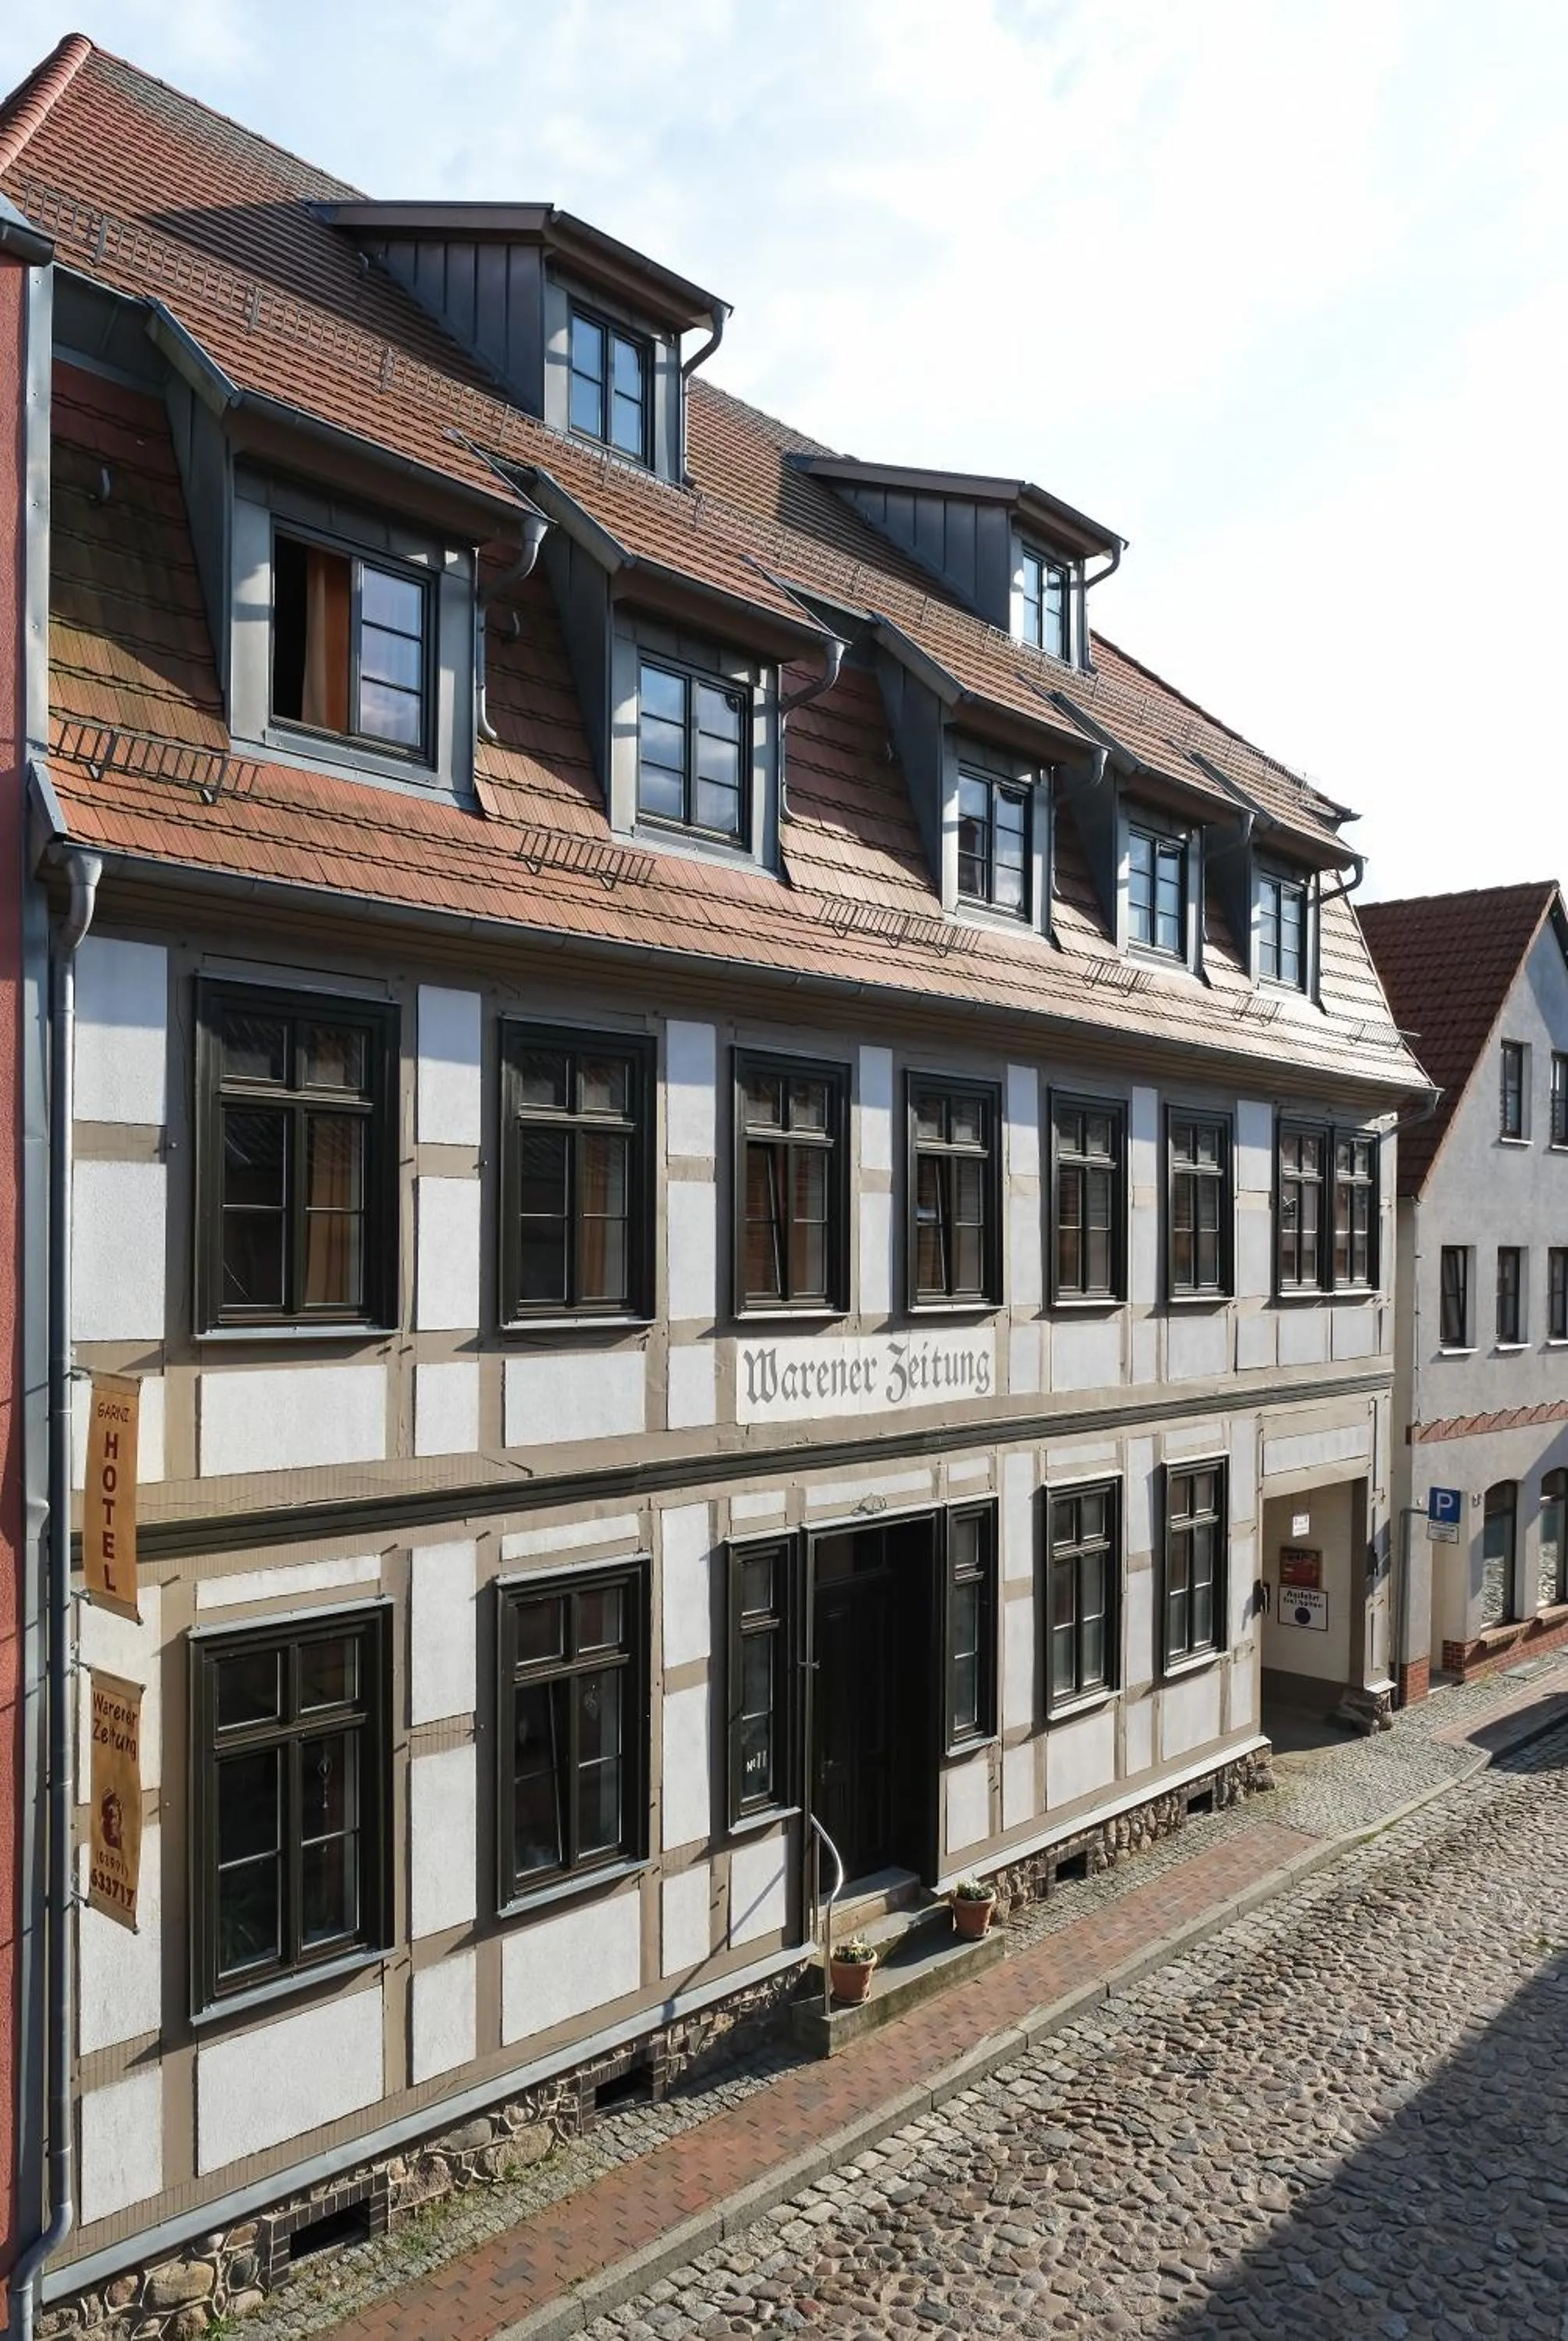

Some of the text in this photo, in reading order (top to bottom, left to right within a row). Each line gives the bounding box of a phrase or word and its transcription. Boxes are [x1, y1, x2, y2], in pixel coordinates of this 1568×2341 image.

[743, 1341, 991, 1405] Warener Zeitung
[98, 1401, 130, 1423] GARNI
[102, 1430, 118, 1592] HOTEL
[1436, 1492, 1453, 1518] P
